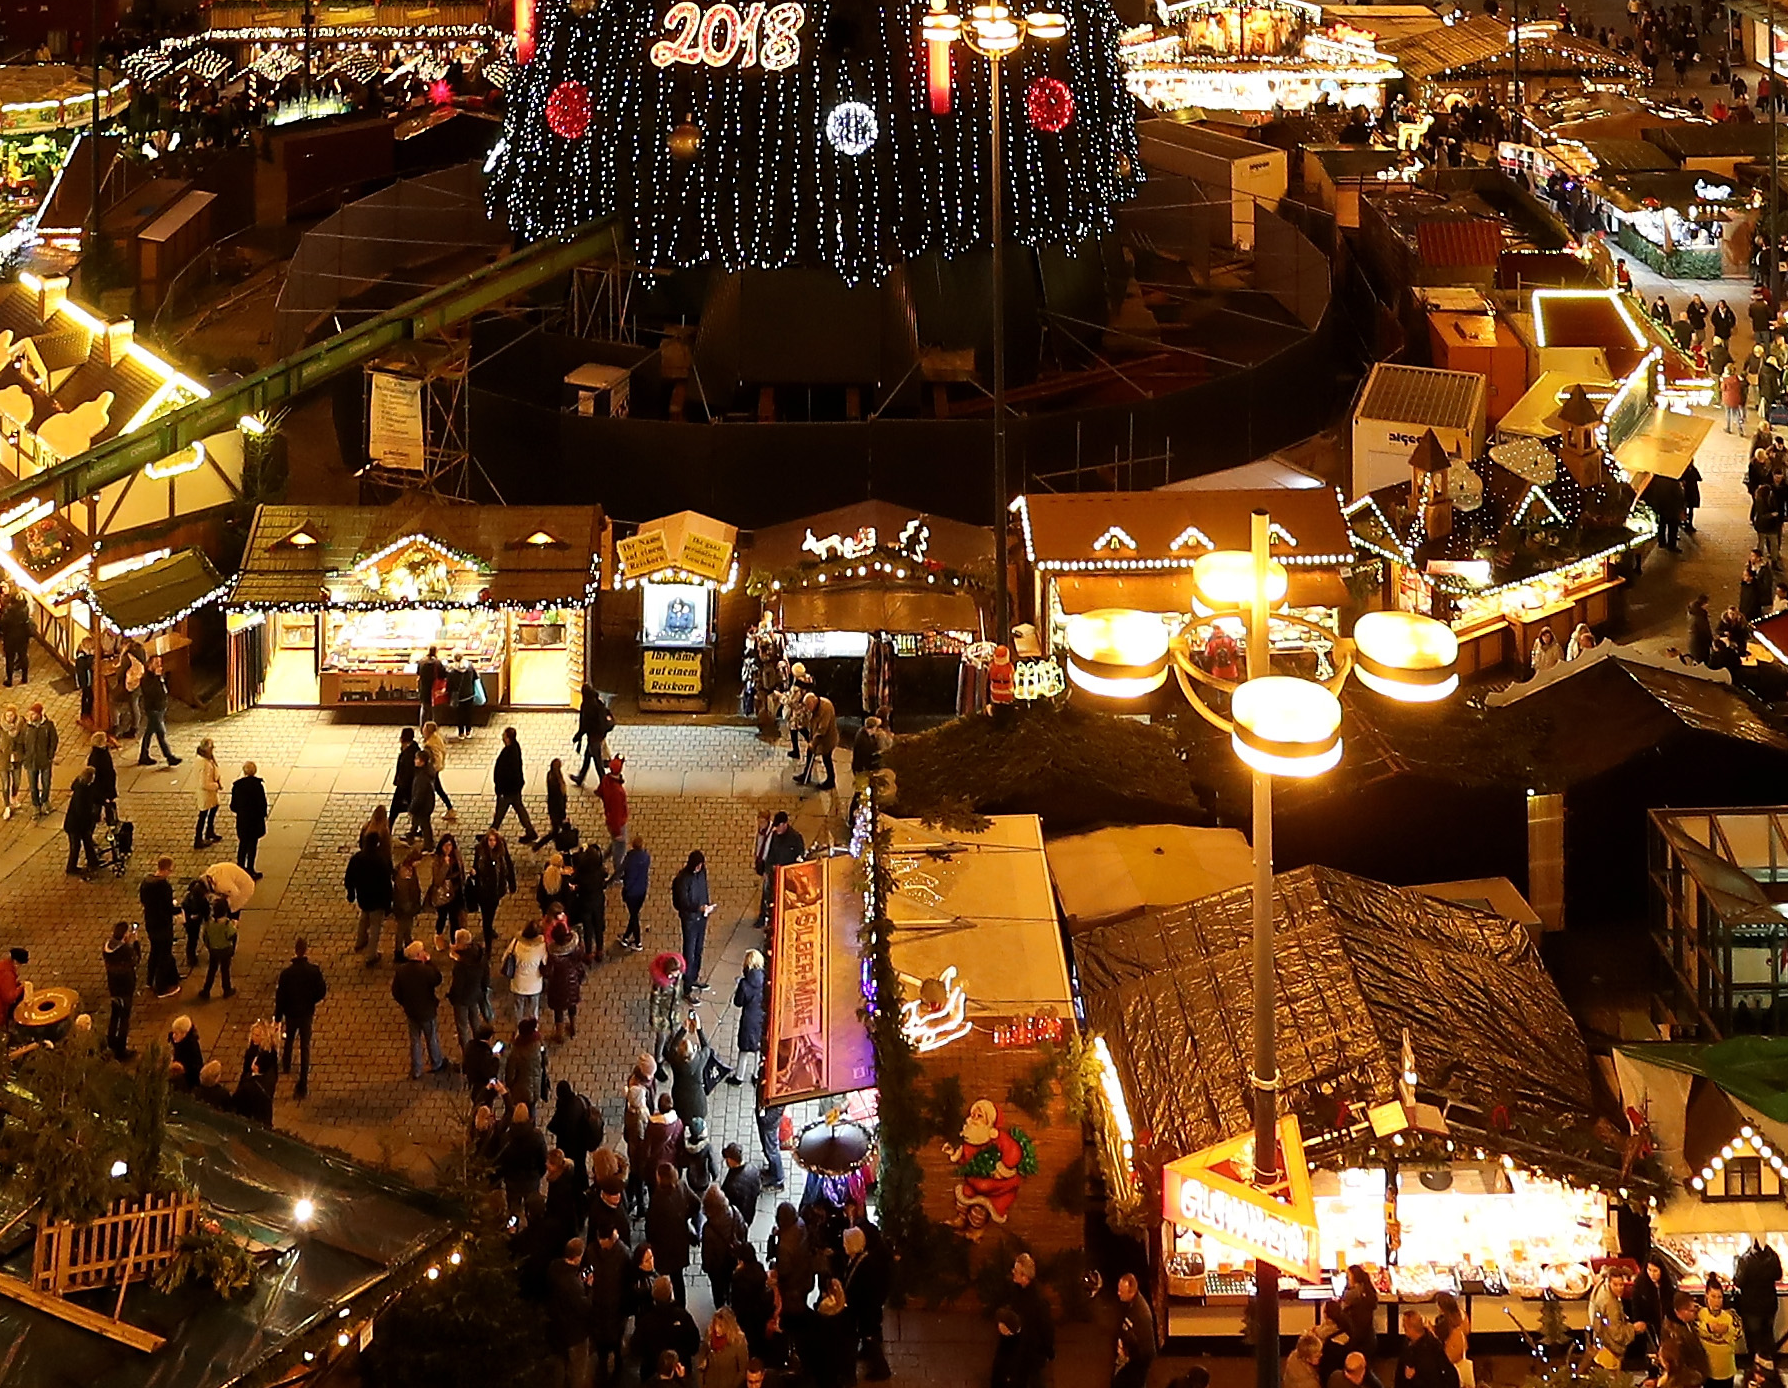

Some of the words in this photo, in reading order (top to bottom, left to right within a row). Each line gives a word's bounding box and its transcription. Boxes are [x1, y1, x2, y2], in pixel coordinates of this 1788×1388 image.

[649, 1, 805, 70] 2018
[651, 650, 666, 661] Ihr
[669, 650, 697, 662] Name
[649, 665, 666, 676] auf
[667, 666, 698, 676] einem
[651, 680, 696, 692] Reiskorn
[792, 912, 818, 1030] SILBER-MINE
